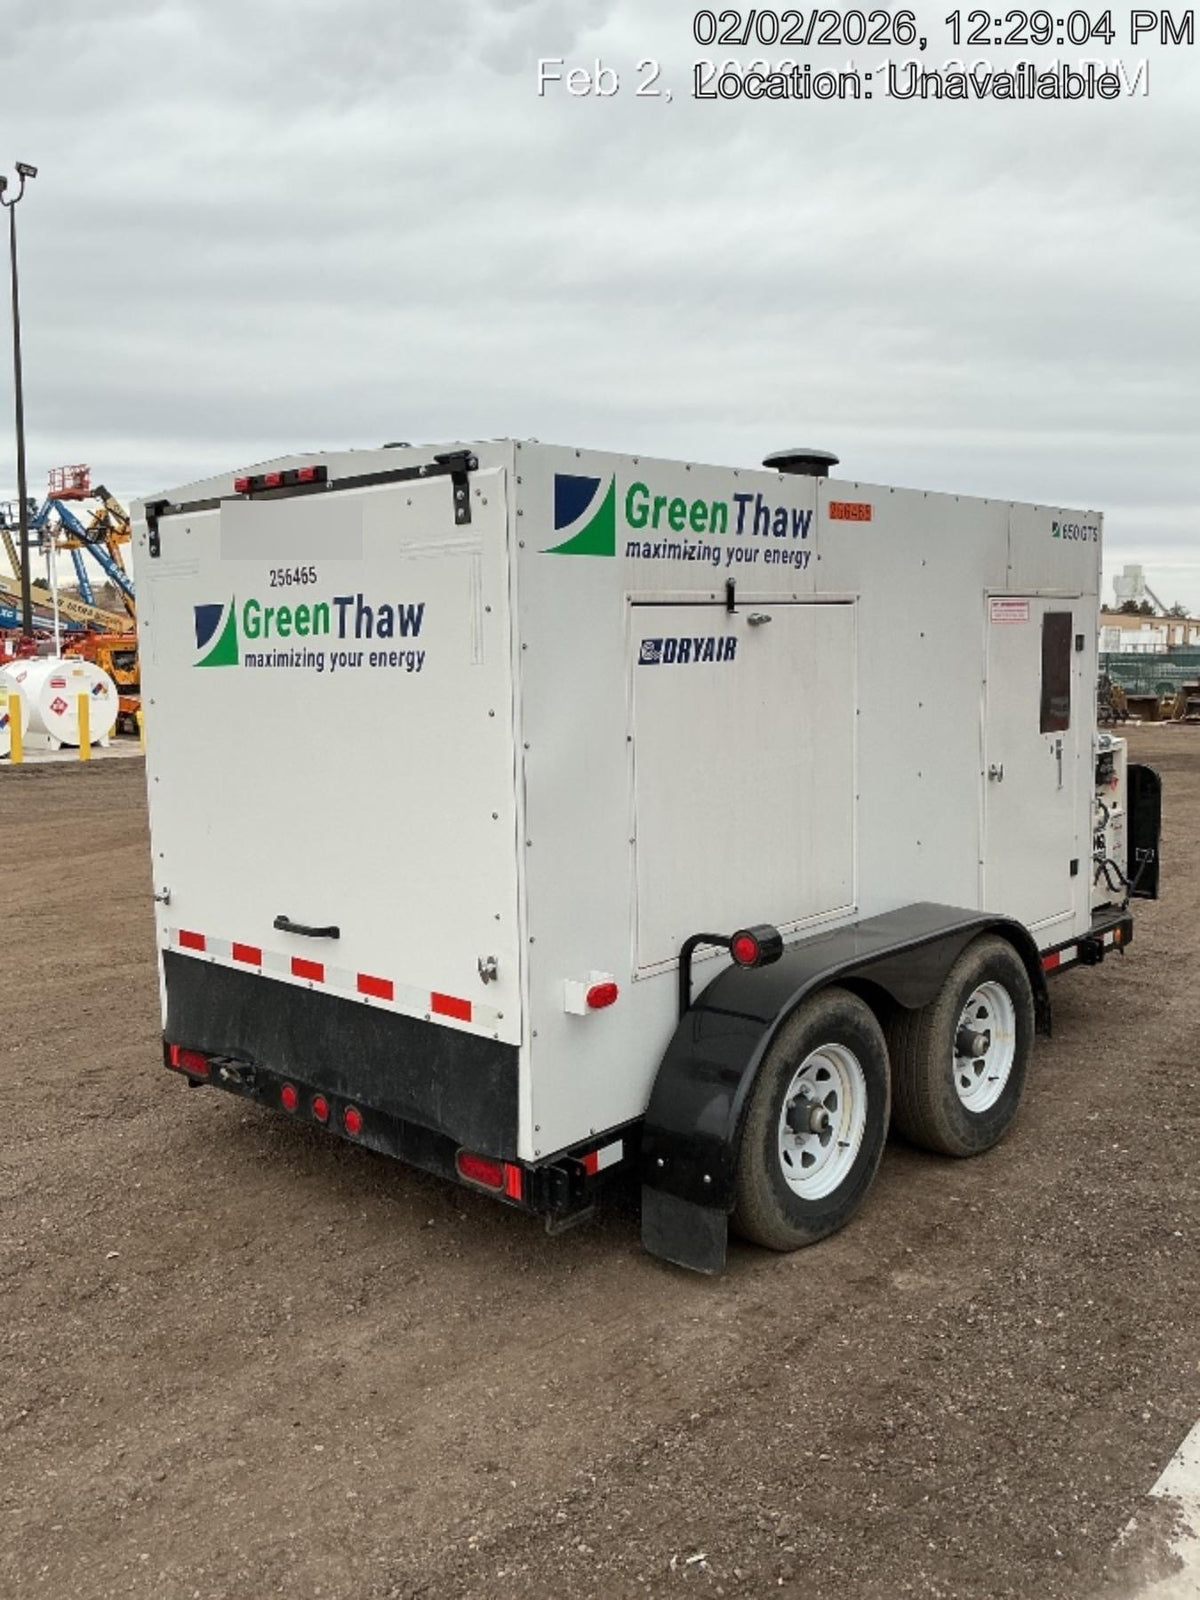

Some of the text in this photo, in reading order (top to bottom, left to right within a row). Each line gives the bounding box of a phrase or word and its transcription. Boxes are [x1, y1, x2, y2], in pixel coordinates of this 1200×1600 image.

[624, 481, 813, 539] GreenThaw
[625, 539, 811, 569] maximizing your energy
[269, 566, 318, 587] 256465
[242, 593, 426, 639] GreenThaw
[244, 648, 426, 673] maximizing your energy
[662, 636, 738, 663] DRYAIR
